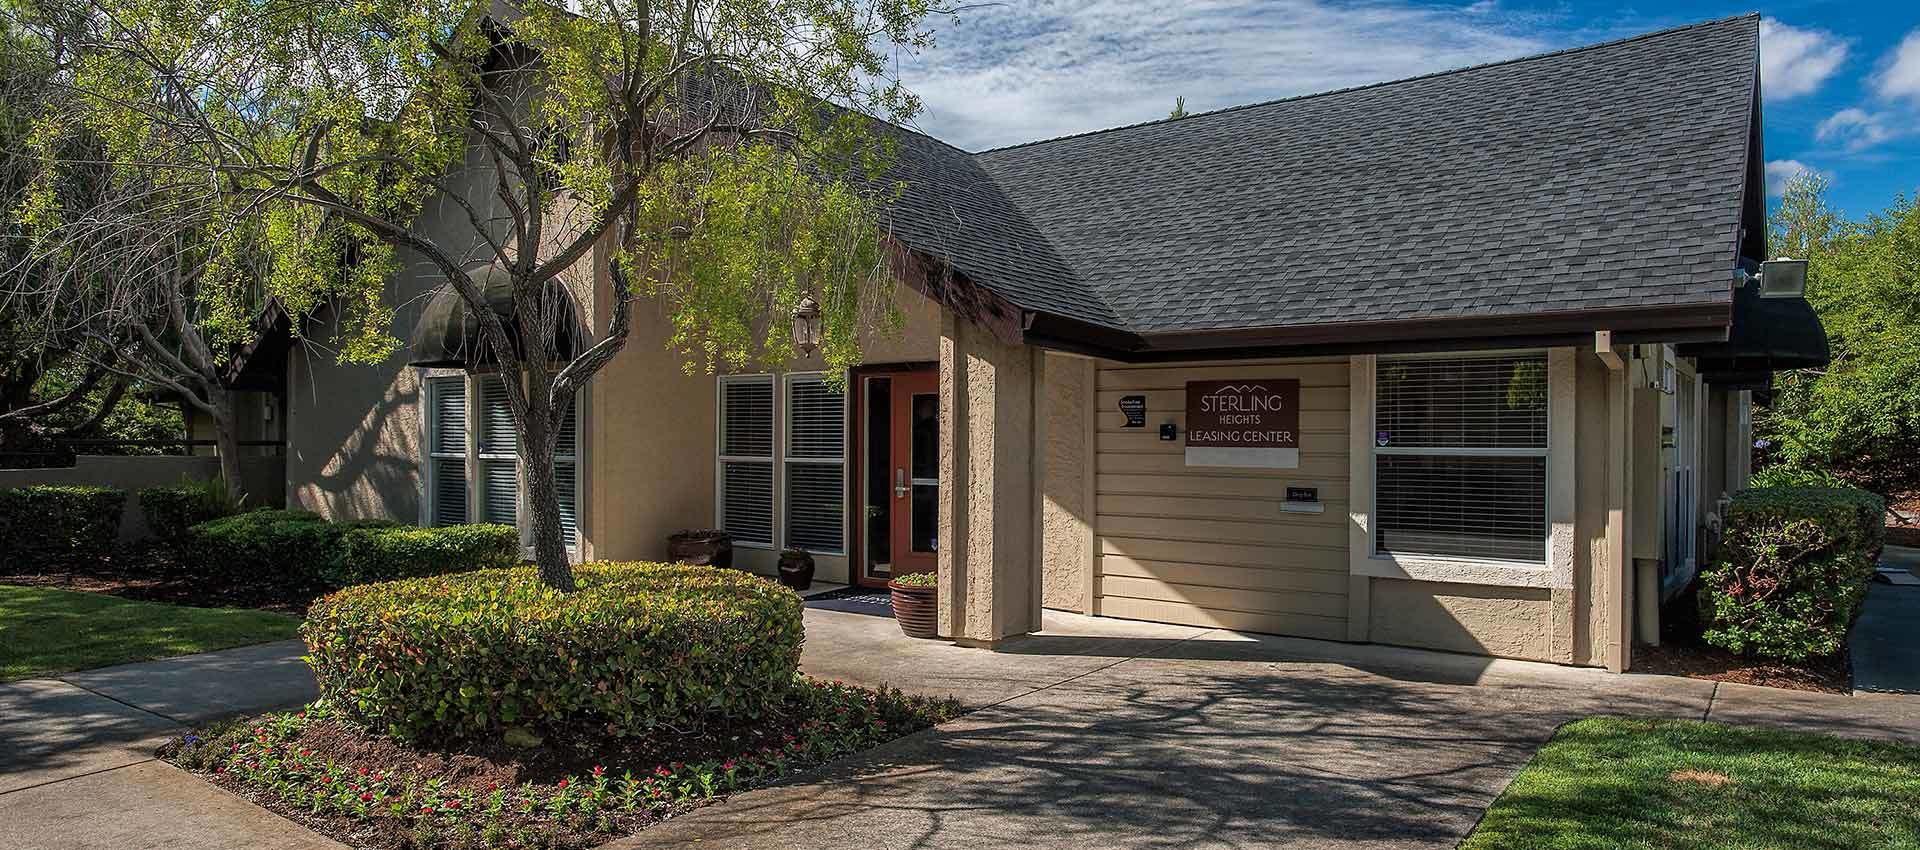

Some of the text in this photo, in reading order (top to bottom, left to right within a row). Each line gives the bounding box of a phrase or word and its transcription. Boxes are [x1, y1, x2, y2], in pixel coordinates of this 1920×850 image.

[1201, 394, 1282, 412] STERLING
[1219, 414, 1261, 425] HEIGHTS
[1190, 430, 1293, 442] LEASING CENTER
